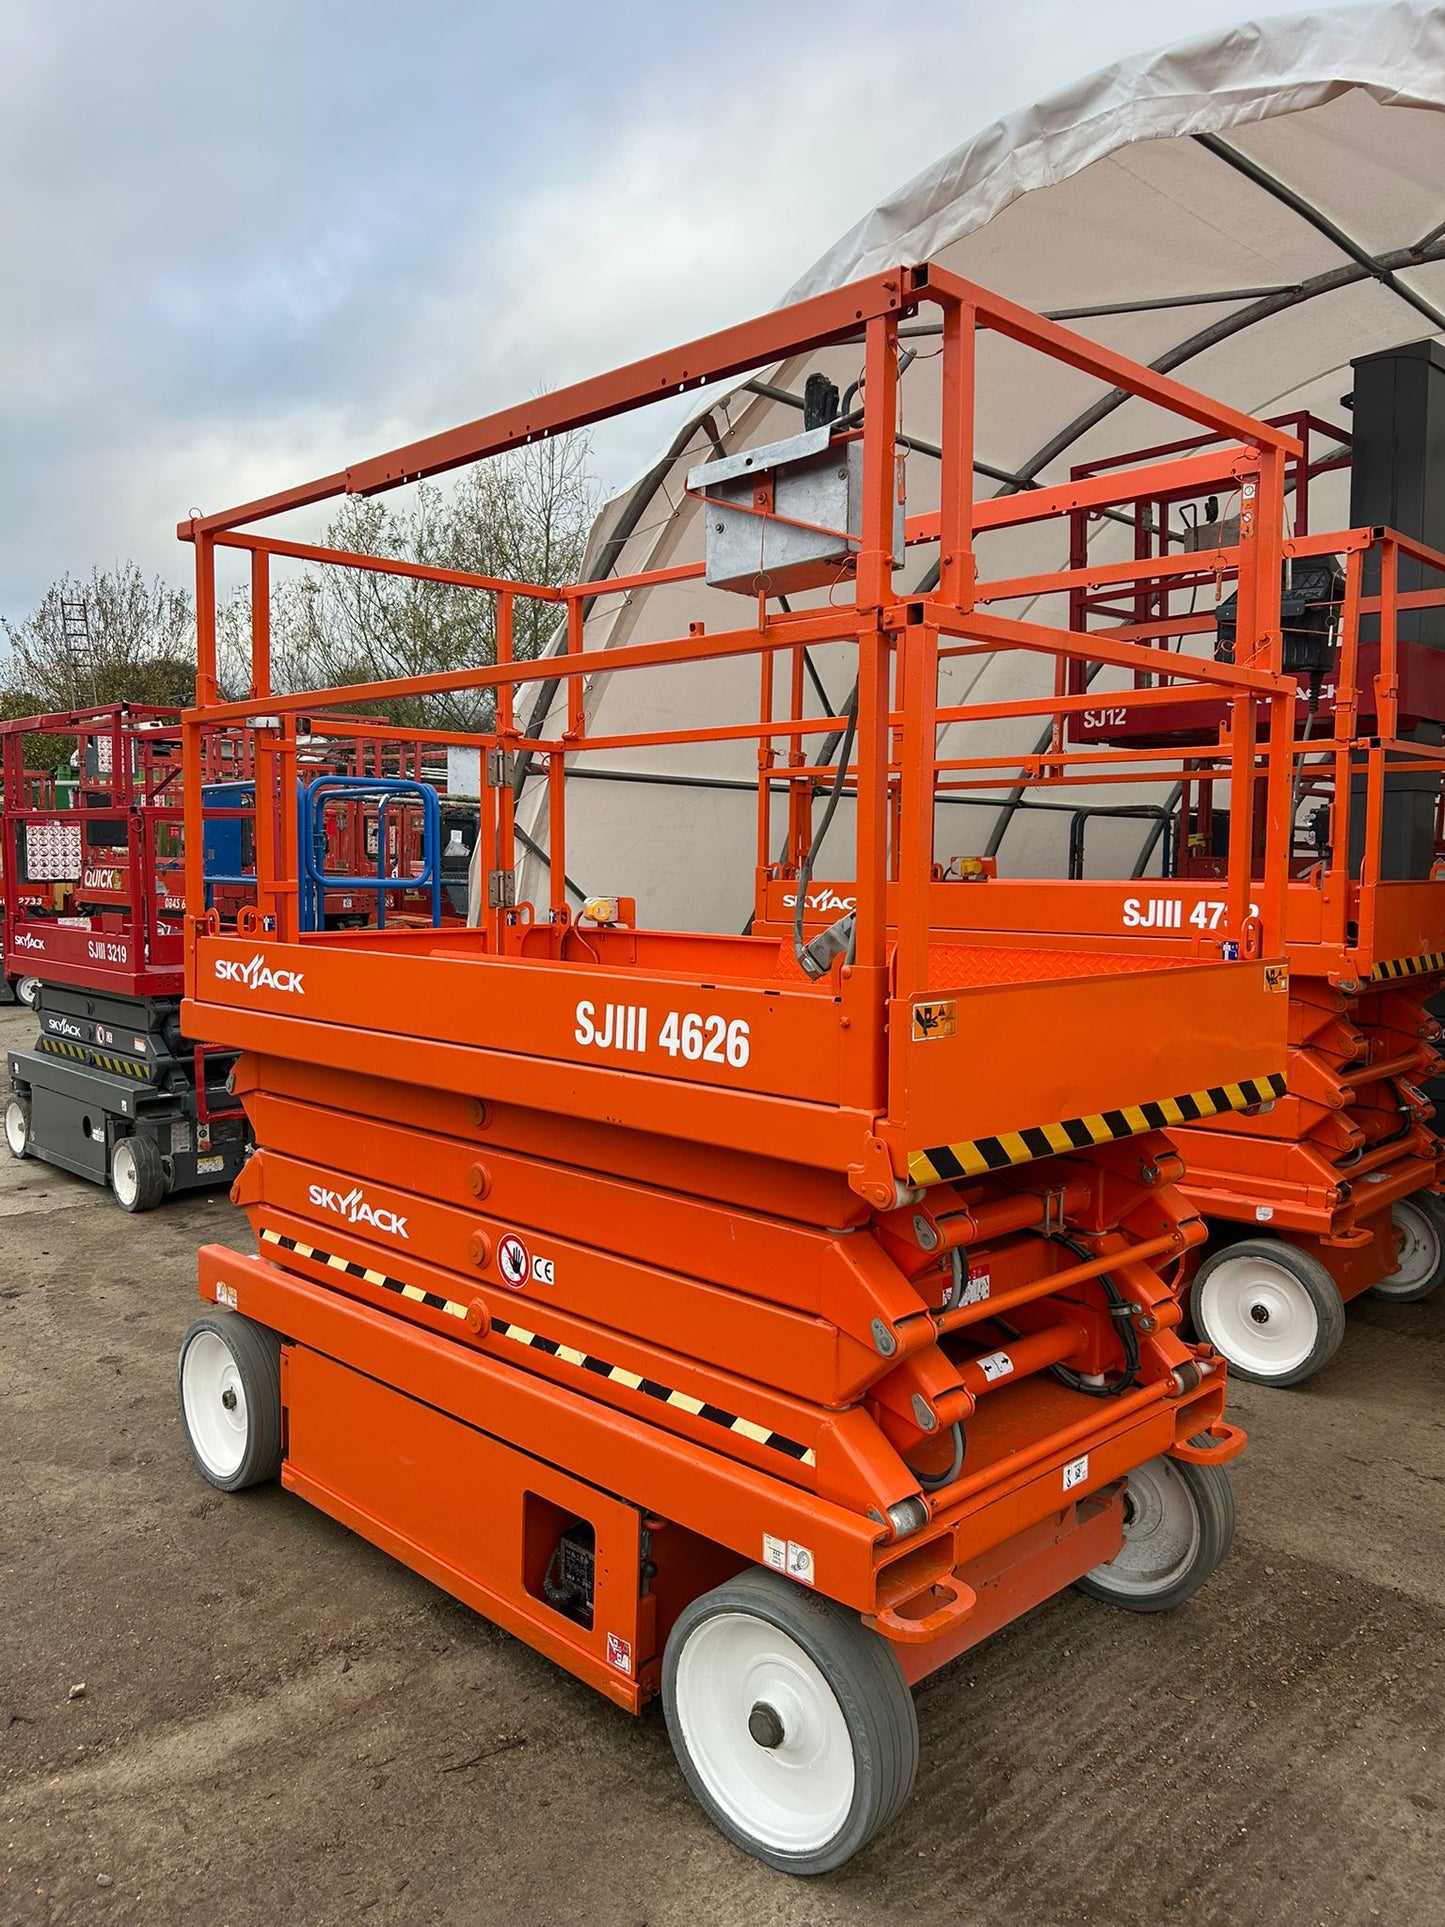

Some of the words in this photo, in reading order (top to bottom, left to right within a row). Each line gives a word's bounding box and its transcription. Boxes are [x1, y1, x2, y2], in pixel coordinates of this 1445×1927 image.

[1083, 708, 1126, 728] SJ12
[84, 868, 114, 889] QUICK
[1122, 898, 1182, 928] SJIII
[14, 932, 45, 950] SKYJACK
[107, 944, 127, 963] 3219
[214, 953, 305, 994] SKYJACK
[48, 1018, 81, 1038] SKYJACK
[574, 1000, 648, 1053] SJIII
[658, 1011, 750, 1068] 4626
[308, 1185, 409, 1239] SKYJACK
[534, 1258, 553, 1282] CE
